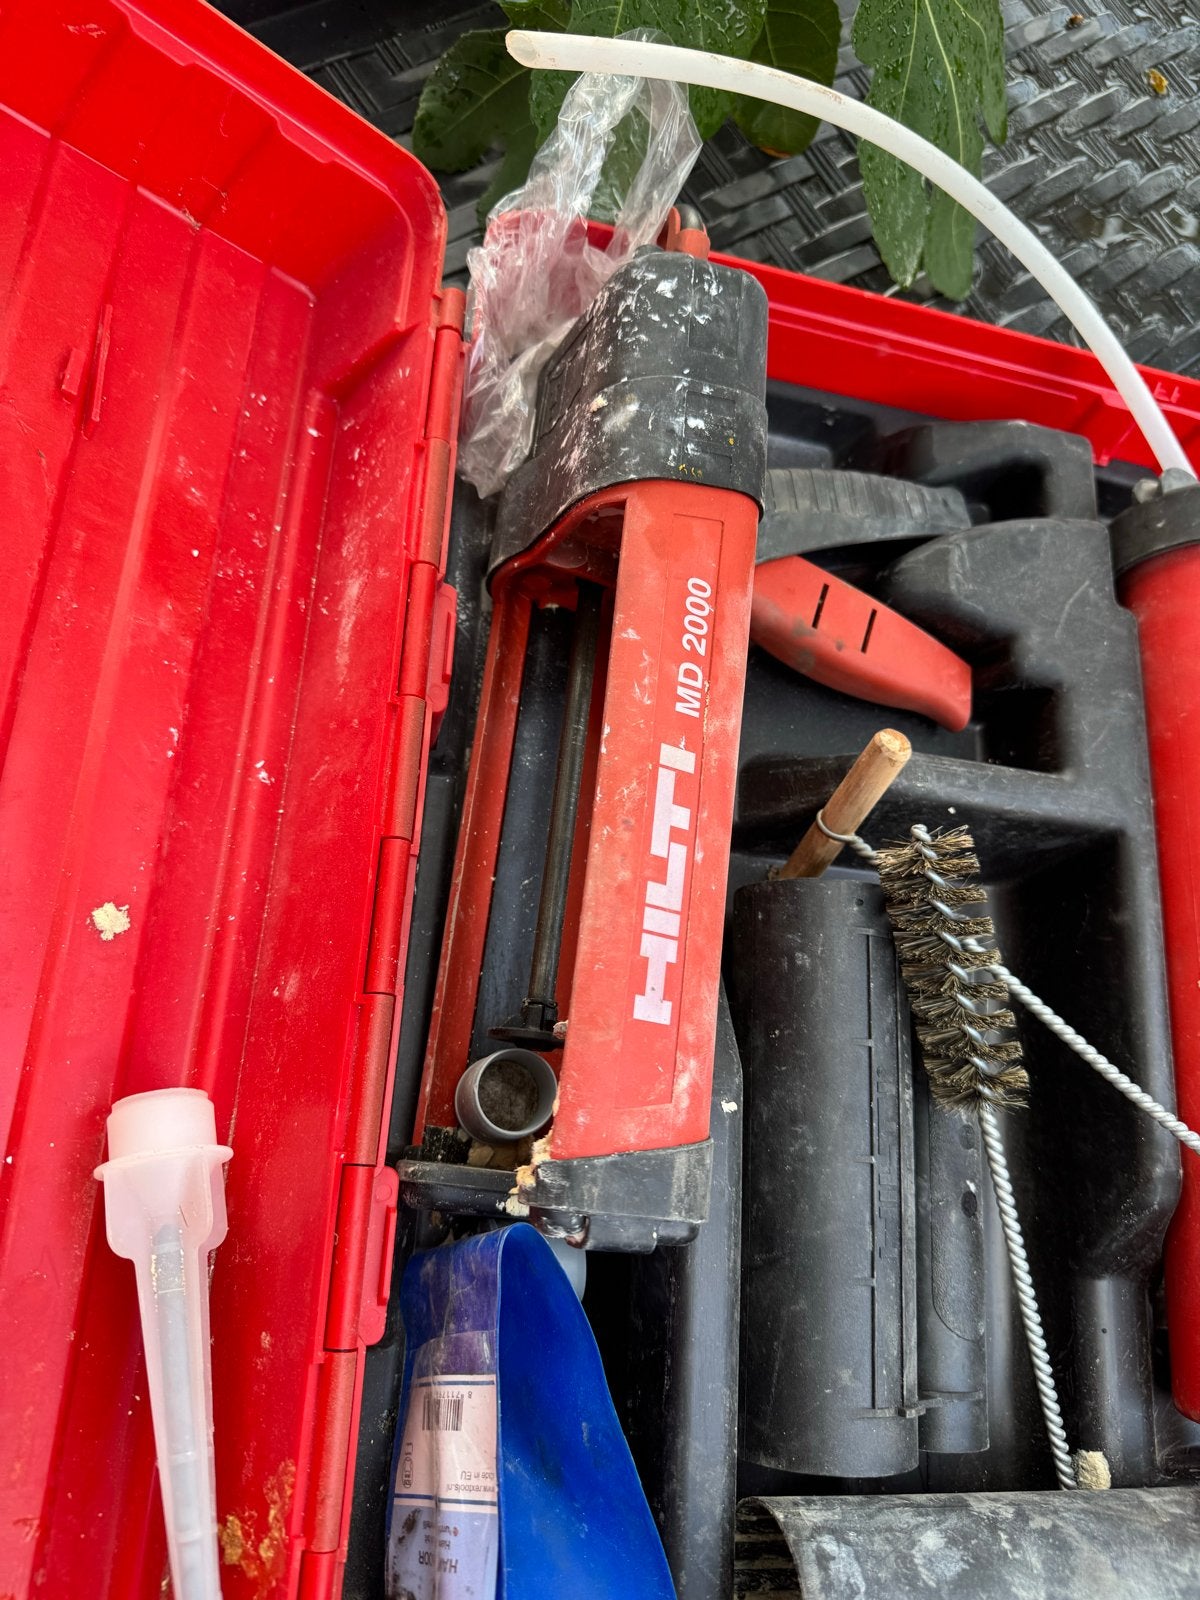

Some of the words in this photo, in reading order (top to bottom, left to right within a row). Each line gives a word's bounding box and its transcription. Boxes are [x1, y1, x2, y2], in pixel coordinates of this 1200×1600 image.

[682, 577, 712, 657] 2000
[675, 662, 703, 718] MD
[633, 743, 696, 1026] HILTI
[460, 1471, 472, 1481] EU
